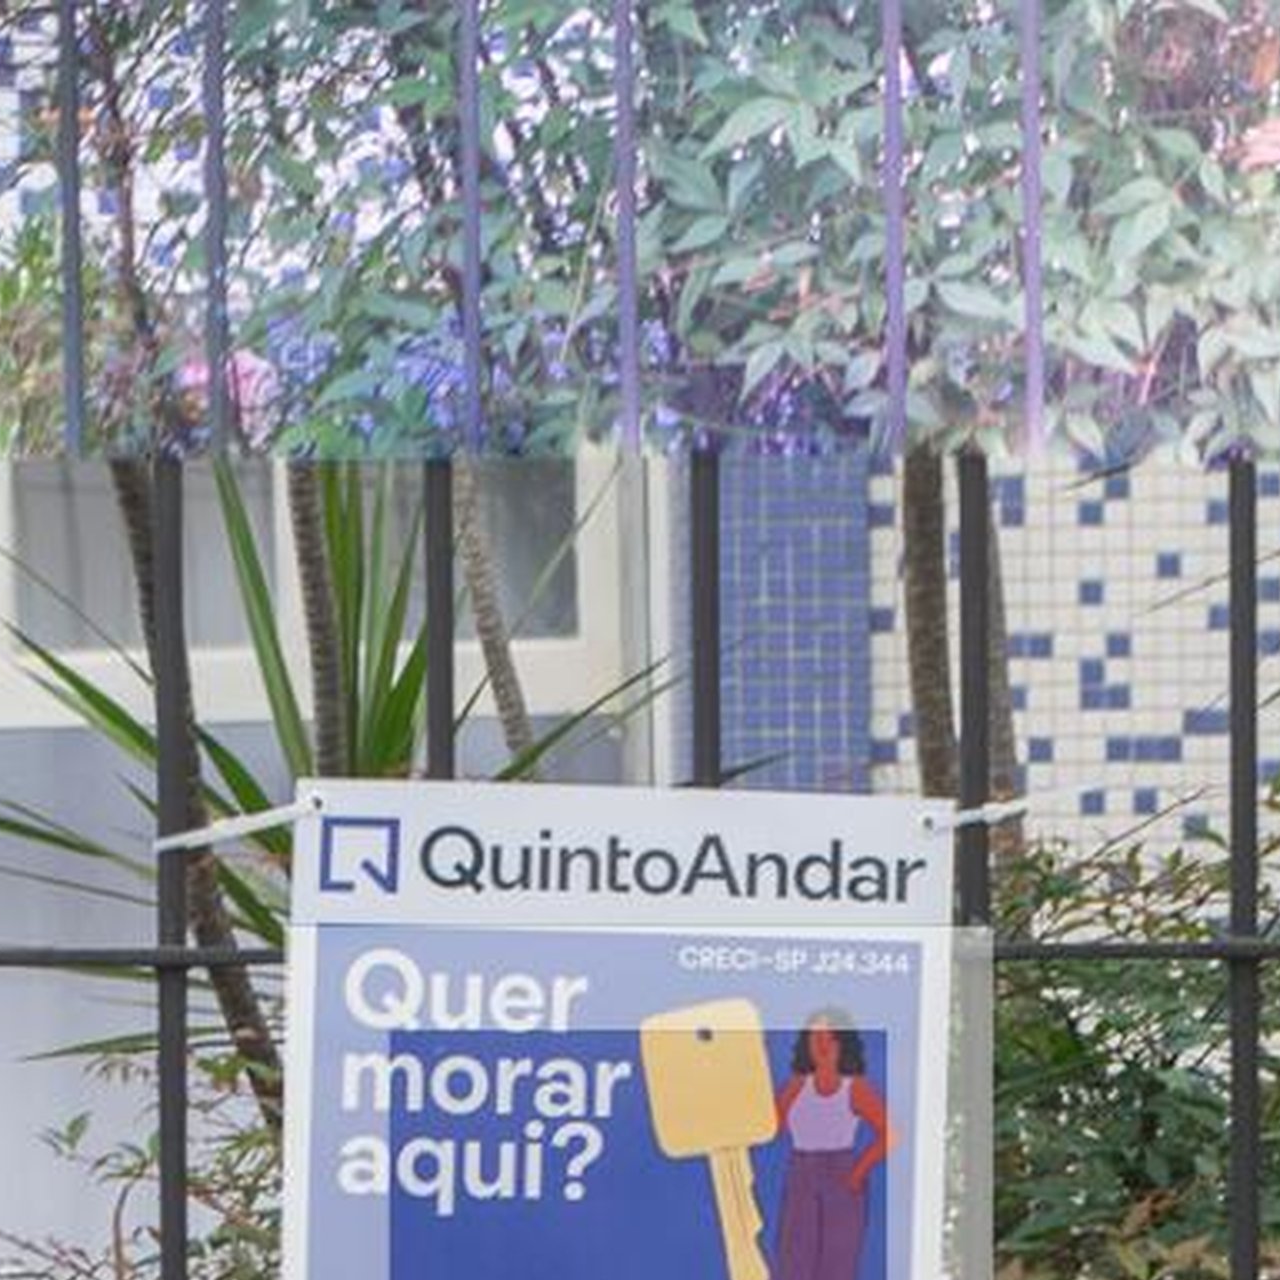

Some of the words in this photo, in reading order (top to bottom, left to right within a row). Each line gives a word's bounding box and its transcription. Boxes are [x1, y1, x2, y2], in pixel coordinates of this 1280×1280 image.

[420, 824, 927, 902] QuintoAndar
[342, 948, 588, 1032] Quer
[342, 1048, 631, 1119] morar
[336, 1121, 606, 1216] aqui?
